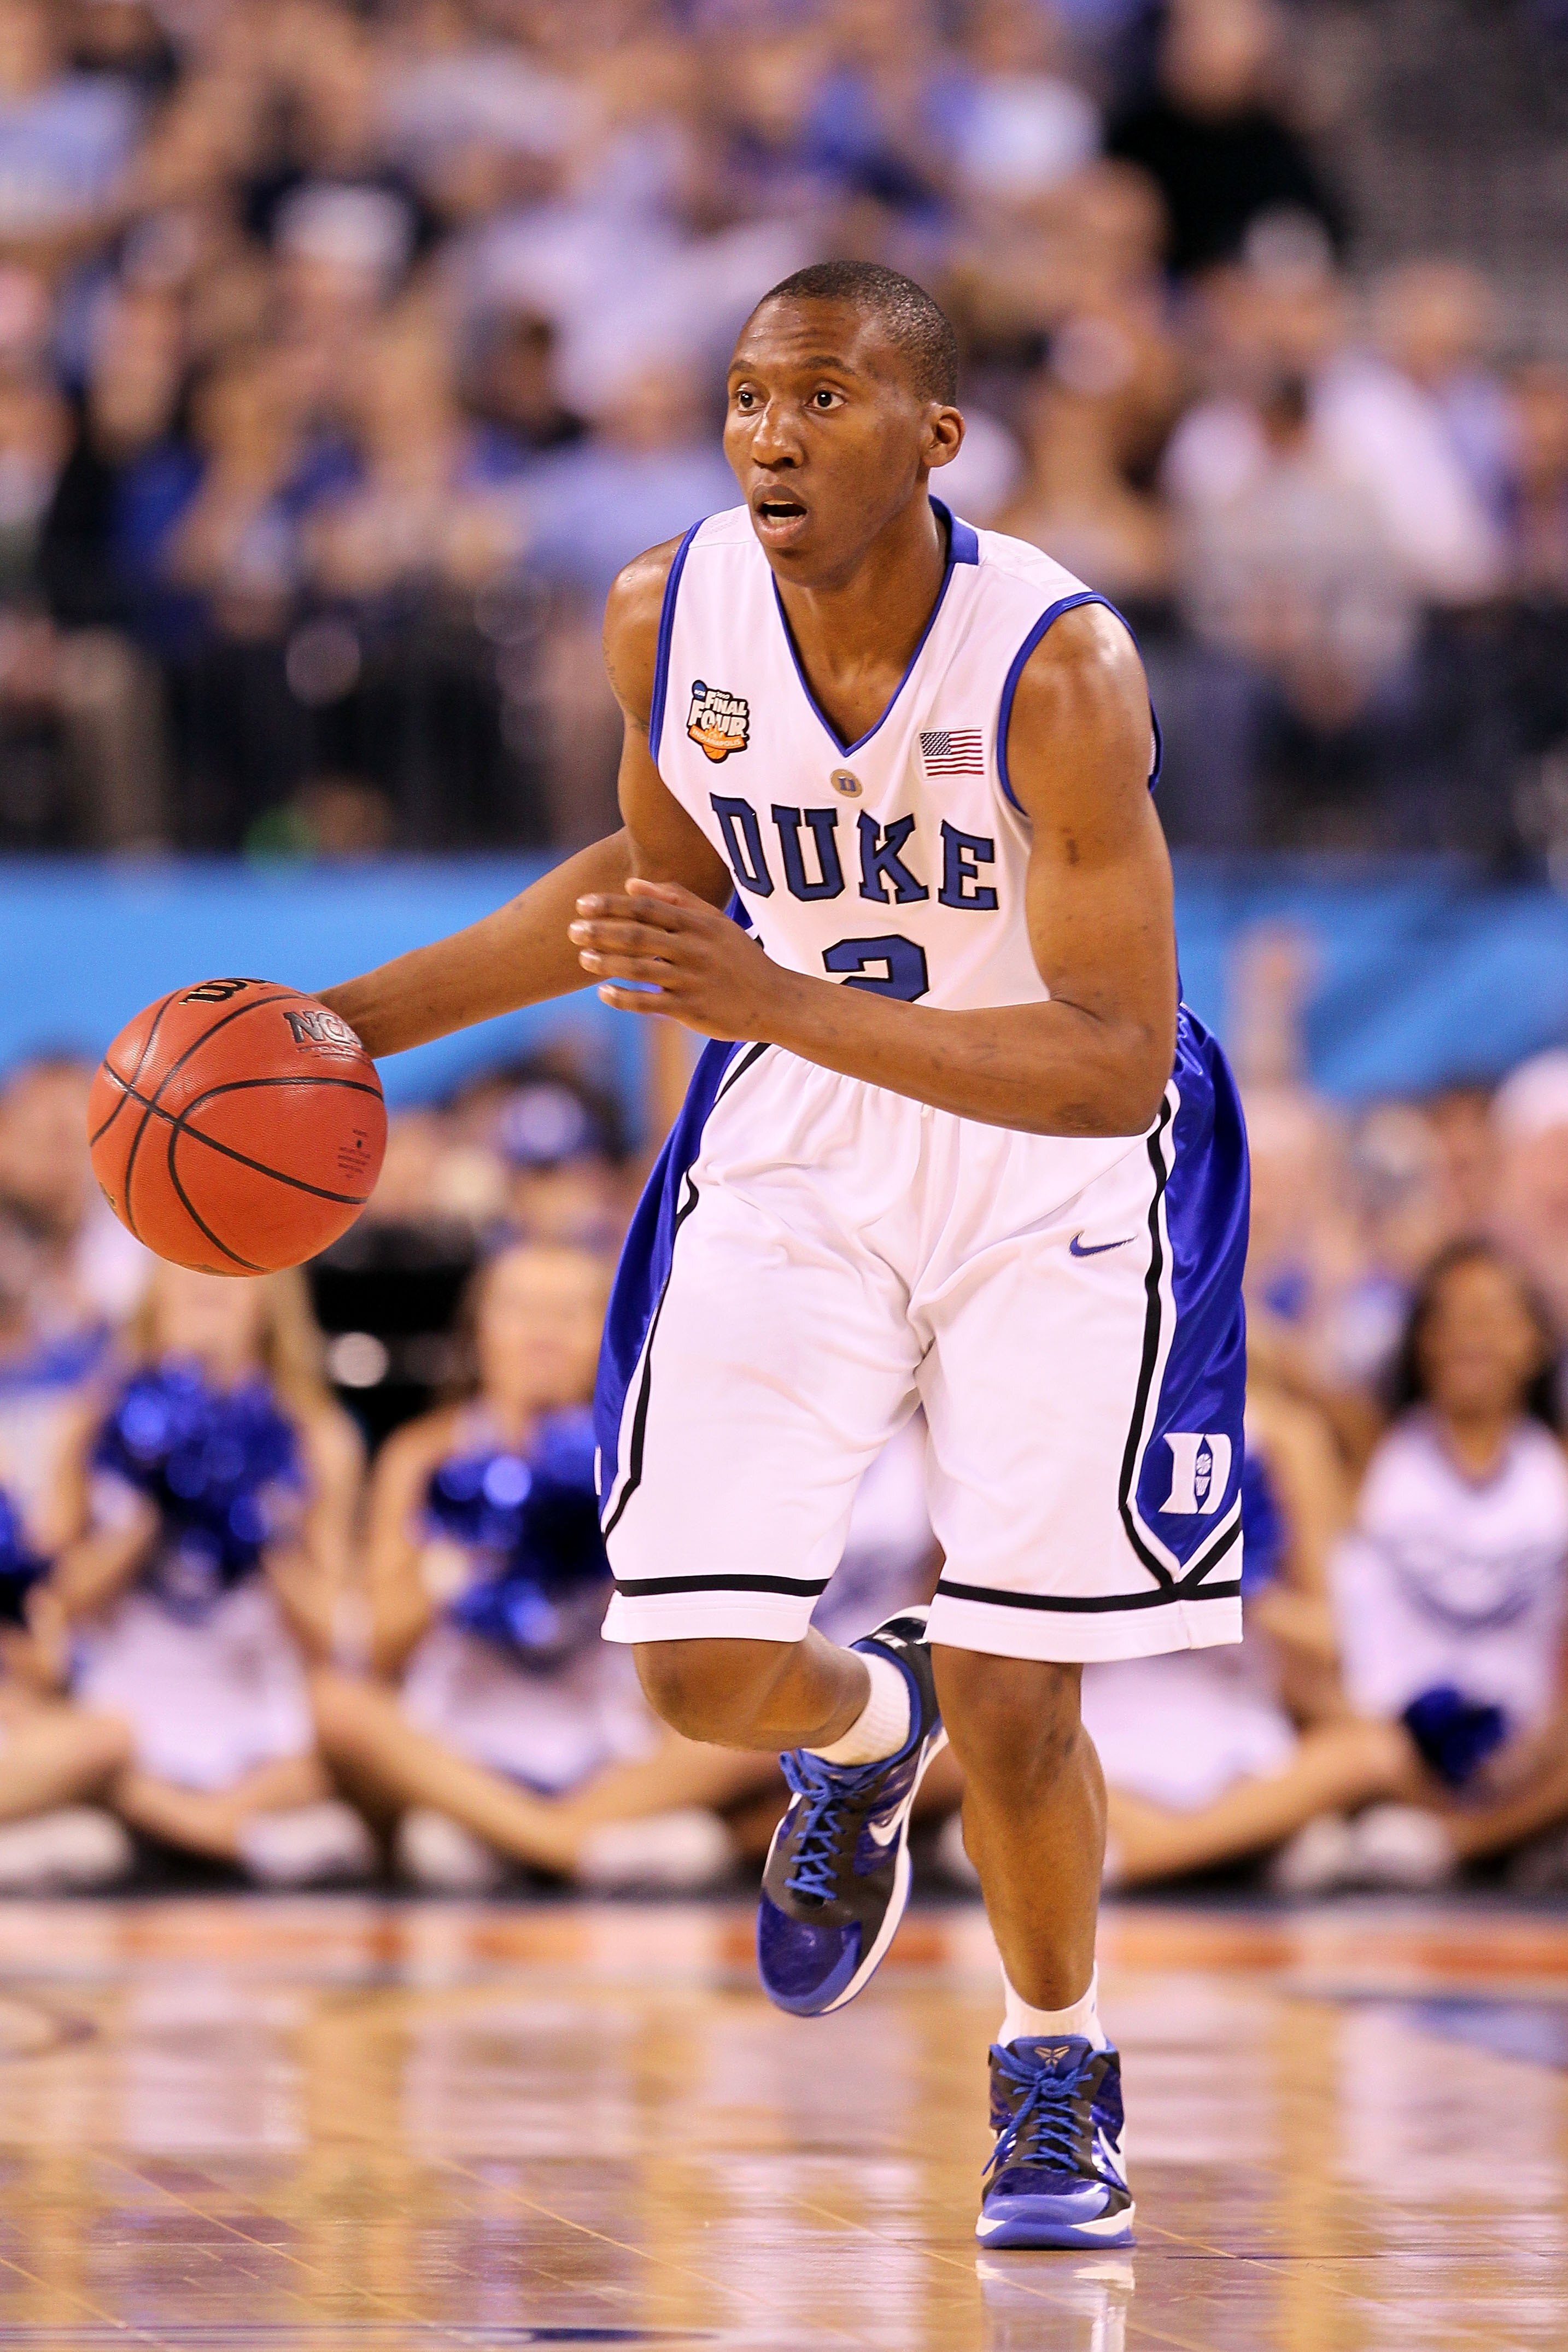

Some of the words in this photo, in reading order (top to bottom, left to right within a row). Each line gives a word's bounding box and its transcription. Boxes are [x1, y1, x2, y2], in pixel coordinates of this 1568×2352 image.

[688, 699, 747, 738] FOUR
[705, 691, 747, 716] FINAL
[709, 792, 999, 910] DUKE
